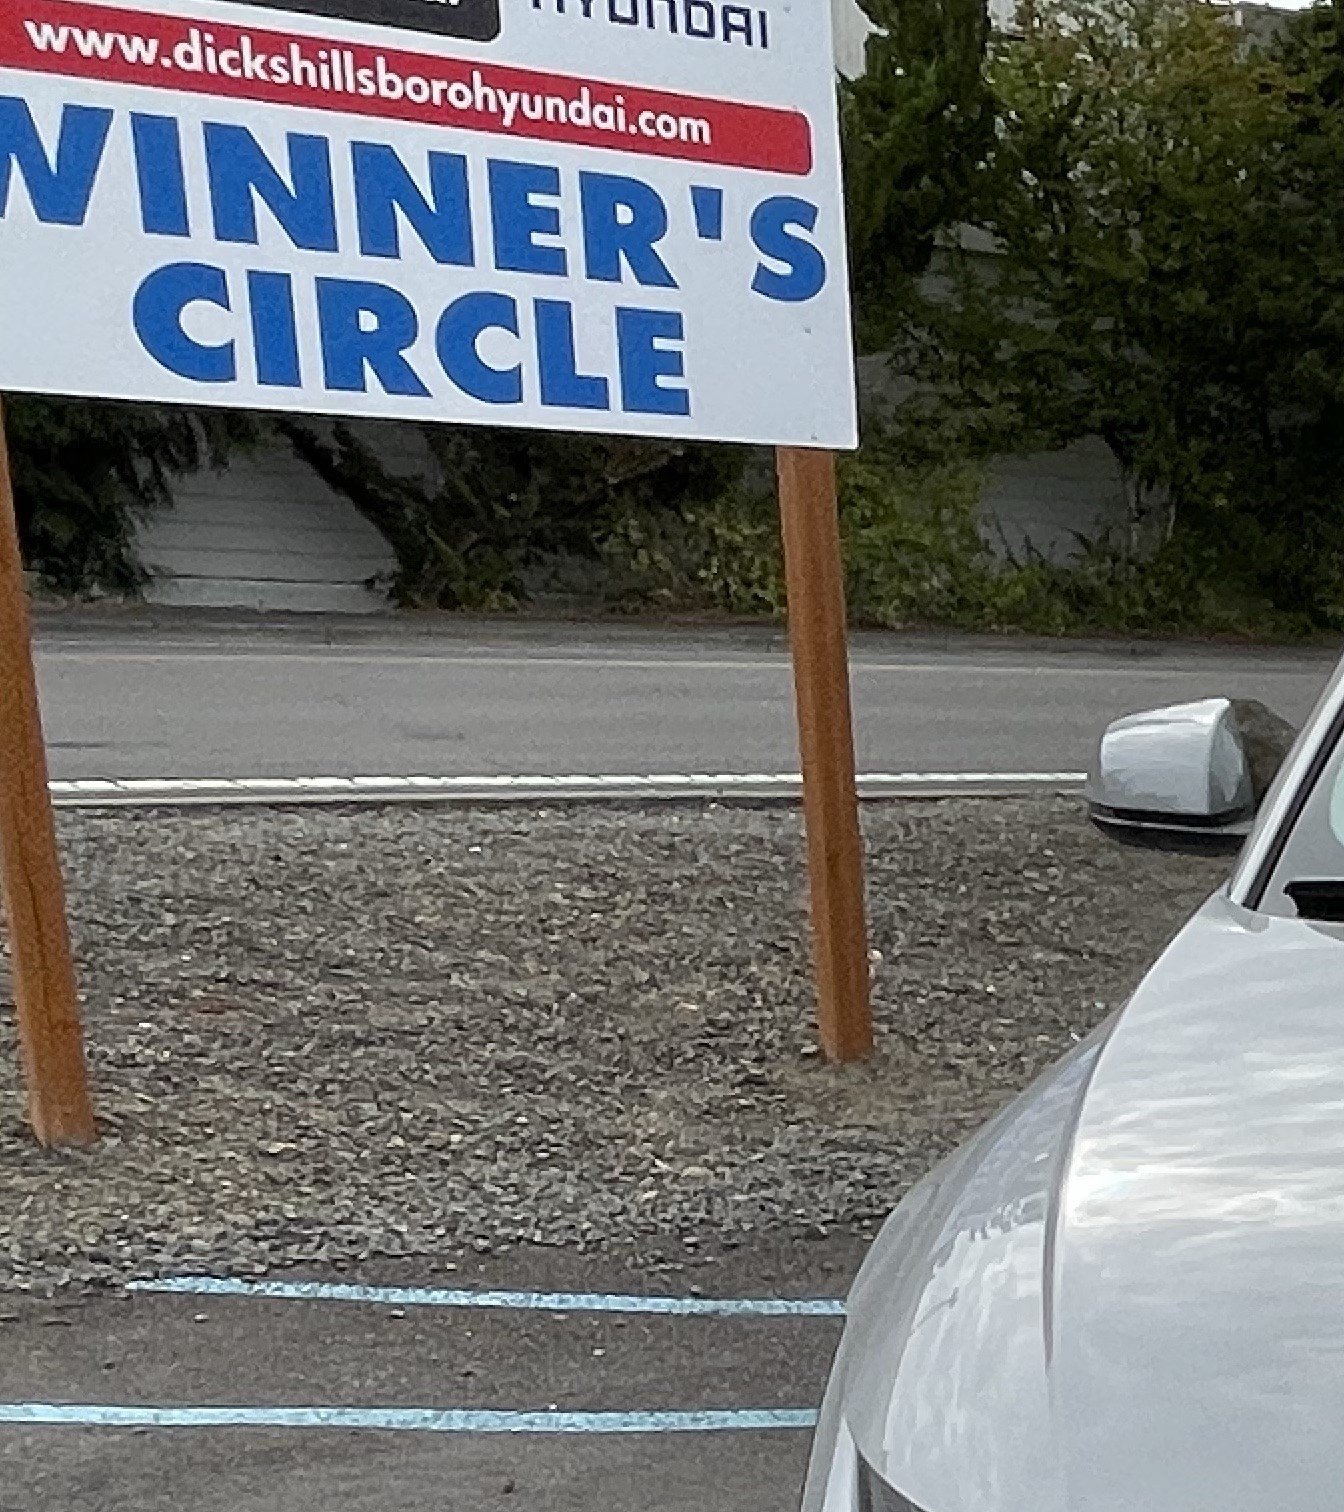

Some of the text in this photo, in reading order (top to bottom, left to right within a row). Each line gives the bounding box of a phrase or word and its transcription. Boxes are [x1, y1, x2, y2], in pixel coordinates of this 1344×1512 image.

[23, 19, 712, 146] www.dickshillsborohyundai.com
[0, 95, 826, 302] WINNER'S
[132, 261, 692, 417] CIRCLE
